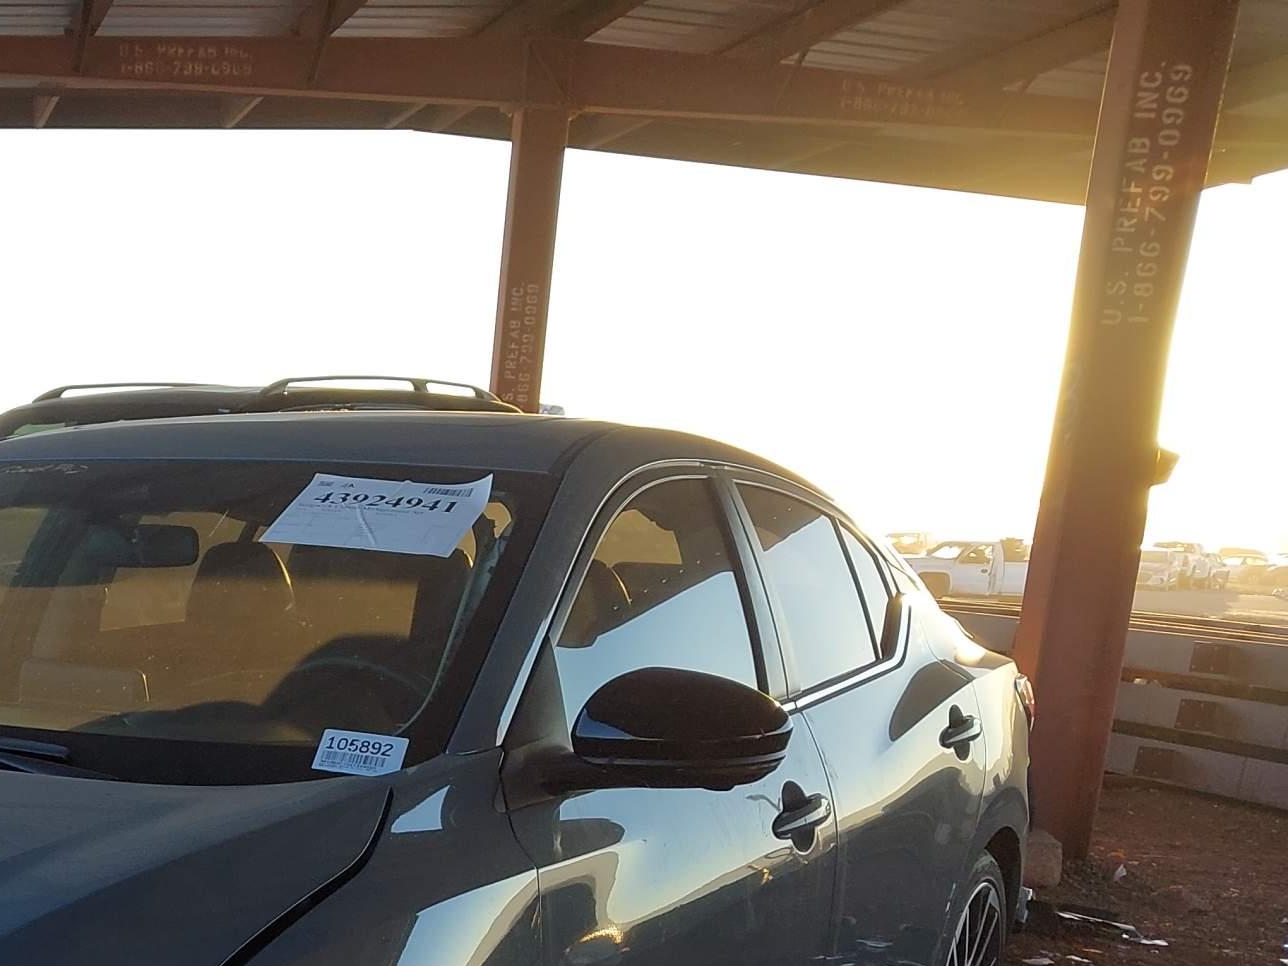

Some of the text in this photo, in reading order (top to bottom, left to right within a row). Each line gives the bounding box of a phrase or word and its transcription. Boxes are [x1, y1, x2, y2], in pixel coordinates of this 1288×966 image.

[1101, 61, 1167, 325] U.S. PREFAB INC.
[1127, 63, 1193, 323] 1-866-799-0969
[504, 320, 521, 380] PREFAB
[314, 492, 459, 513] 43924941
[325, 736, 394, 757] 105892
